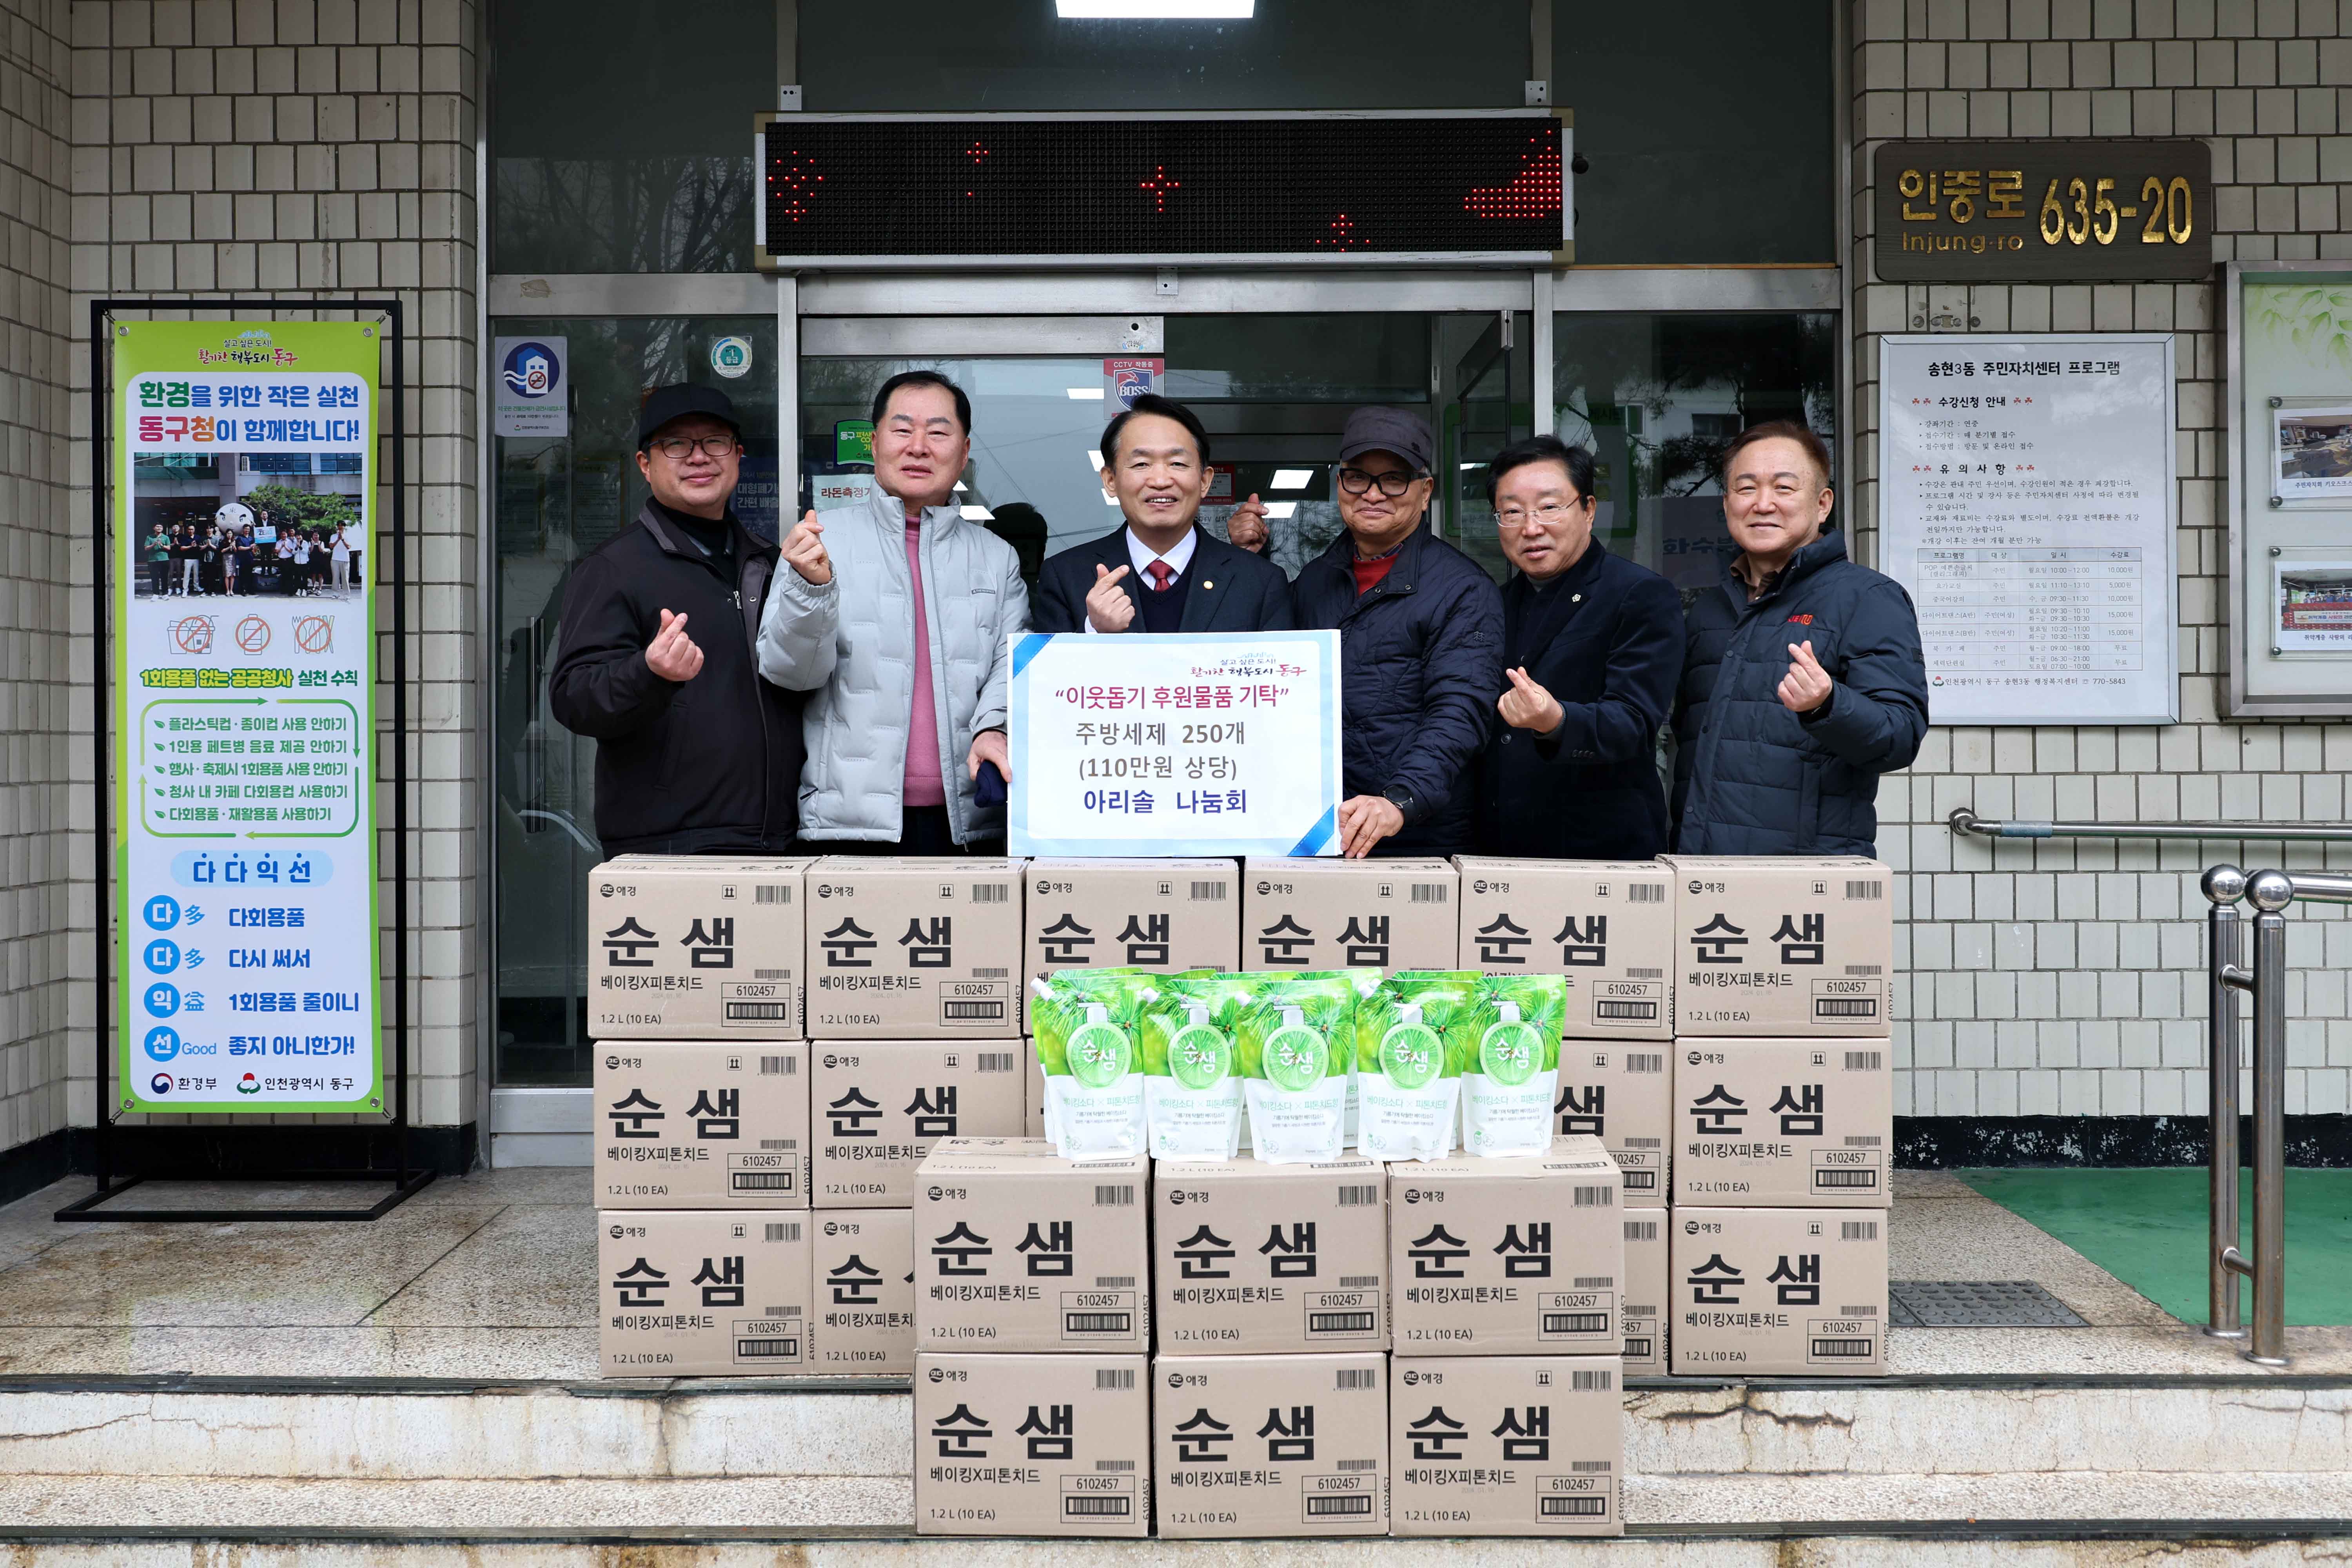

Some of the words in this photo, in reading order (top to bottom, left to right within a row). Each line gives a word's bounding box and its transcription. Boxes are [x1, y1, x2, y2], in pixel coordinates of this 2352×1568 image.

[1898, 170, 2025, 224] 인중로
[2040, 177, 2192, 245] 635-20
[224, 339, 238, 348] 살고
[198, 348, 228, 365] 활기찬
[231, 350, 269, 365] 행복도시
[269, 348, 298, 367] 동구
[1929, 361, 1975, 376] 송현3동
[1983, 362, 2060, 375] 주민자치센터
[2069, 361, 2119, 375] 프로그램
[140, 381, 211, 407] 환경을
[219, 386, 261, 407] 위한
[268, 386, 310, 407] 작은
[317, 386, 358, 407] 실천
[1120, 386, 1149, 396] BOSS
[1938, 397, 1978, 408] 수강신청
[1986, 397, 2005, 407] 안내
[139, 416, 236, 441] 동구청이
[244, 419, 359, 441] 함께합니다!
[737, 483, 779, 495] 대형폐기
[140, 668, 196, 688] 1회용품
[197, 668, 230, 688] 없는
[230, 668, 293, 688] 공공청사
[298, 670, 327, 686] 실천
[331, 670, 358, 686] 수칙
[1191, 667, 1224, 677] 활기찬
[1229, 667, 1272, 677] 행복도시
[1276, 664, 1307, 677] 동구
[1056, 686, 1144, 709] “이웃돕기
[1152, 686, 1233, 709] 후원물품
[1240, 684, 1289, 708] 기탁”
[169, 718, 230, 731] 플라스틱컵
[241, 718, 278, 731] 종이컵
[282, 718, 307, 731] 사용
[311, 717, 346, 731] 안하기
[1076, 723, 1165, 746] 주방세제
[1183, 722, 1244, 744] 250개
[169, 740, 202, 753] 1인용
[207, 740, 244, 753] 페트병
[250, 740, 274, 753] 음료
[280, 740, 305, 753] 제공
[310, 740, 346, 753] 안하기
[169, 762, 194, 775] 행사
[203, 762, 238, 775] 축제시
[241, 763, 283, 775] 1회용품
[286, 762, 310, 775] 사용
[313, 762, 347, 775] 안하기
[1080, 756, 1172, 780] (110만원
[1185, 756, 1236, 780] 상당)
[169, 785, 195, 798] 청사
[199, 785, 211, 798] 내
[215, 785, 239, 798] 카페
[245, 785, 294, 798] 다회용컵
[299, 785, 347, 798] 사용하기
[1084, 790, 1154, 813] 아리솔
[1177, 789, 1246, 813] 나눔회
[170, 808, 219, 820] 다회용품
[229, 808, 278, 820] 재활용품
[281, 808, 330, 820] 사용하기
[194, 861, 216, 883] 다
[225, 861, 248, 883] 다
[257, 861, 278, 883] 익
[289, 861, 310, 882] 선
[616, 886, 636, 896] 애경
[153, 903, 172, 922] 다
[185, 905, 205, 926] 多
[229, 908, 305, 927] 다회용품
[603, 917, 659, 967] 순
[680, 918, 733, 968] 샘
[153, 947, 172, 966] 다
[185, 948, 205, 969] 多
[229, 949, 265, 968] 다시
[272, 949, 310, 968] 써서
[601, 975, 702, 991] 베이킹X피톤치드
[736, 985, 776, 996] 6102457
[153, 991, 171, 1010] 익
[229, 993, 296, 1012] 1회용품
[303, 993, 358, 1011] 줄이니
[601, 1014, 615, 1023] 1.2
[619, 1014, 623, 1023] L
[626, 1014, 641, 1024] (10
[645, 1014, 661, 1025] EA)
[153, 1034, 171, 1053] 선
[182, 1042, 216, 1054] Good
[273, 1036, 354, 1055] 아니한가!
[179, 1078, 216, 1090] 환경부
[265, 1078, 323, 1090] 인천광역시
[330, 1078, 354, 1090] 동구
[1421, 1374, 1442, 1384] 애경
[1406, 1406, 1468, 1459] 순
[1491, 1406, 1549, 1461] 샘
[1405, 1469, 1516, 1485] 베이킹X피톤치드
[1552, 1479, 1595, 1491] 6102457
[1405, 1511, 1419, 1520] 1.2
[1424, 1511, 1429, 1520] L
[1432, 1510, 1448, 1521] (10
[1453, 1510, 1470, 1522] EA)
